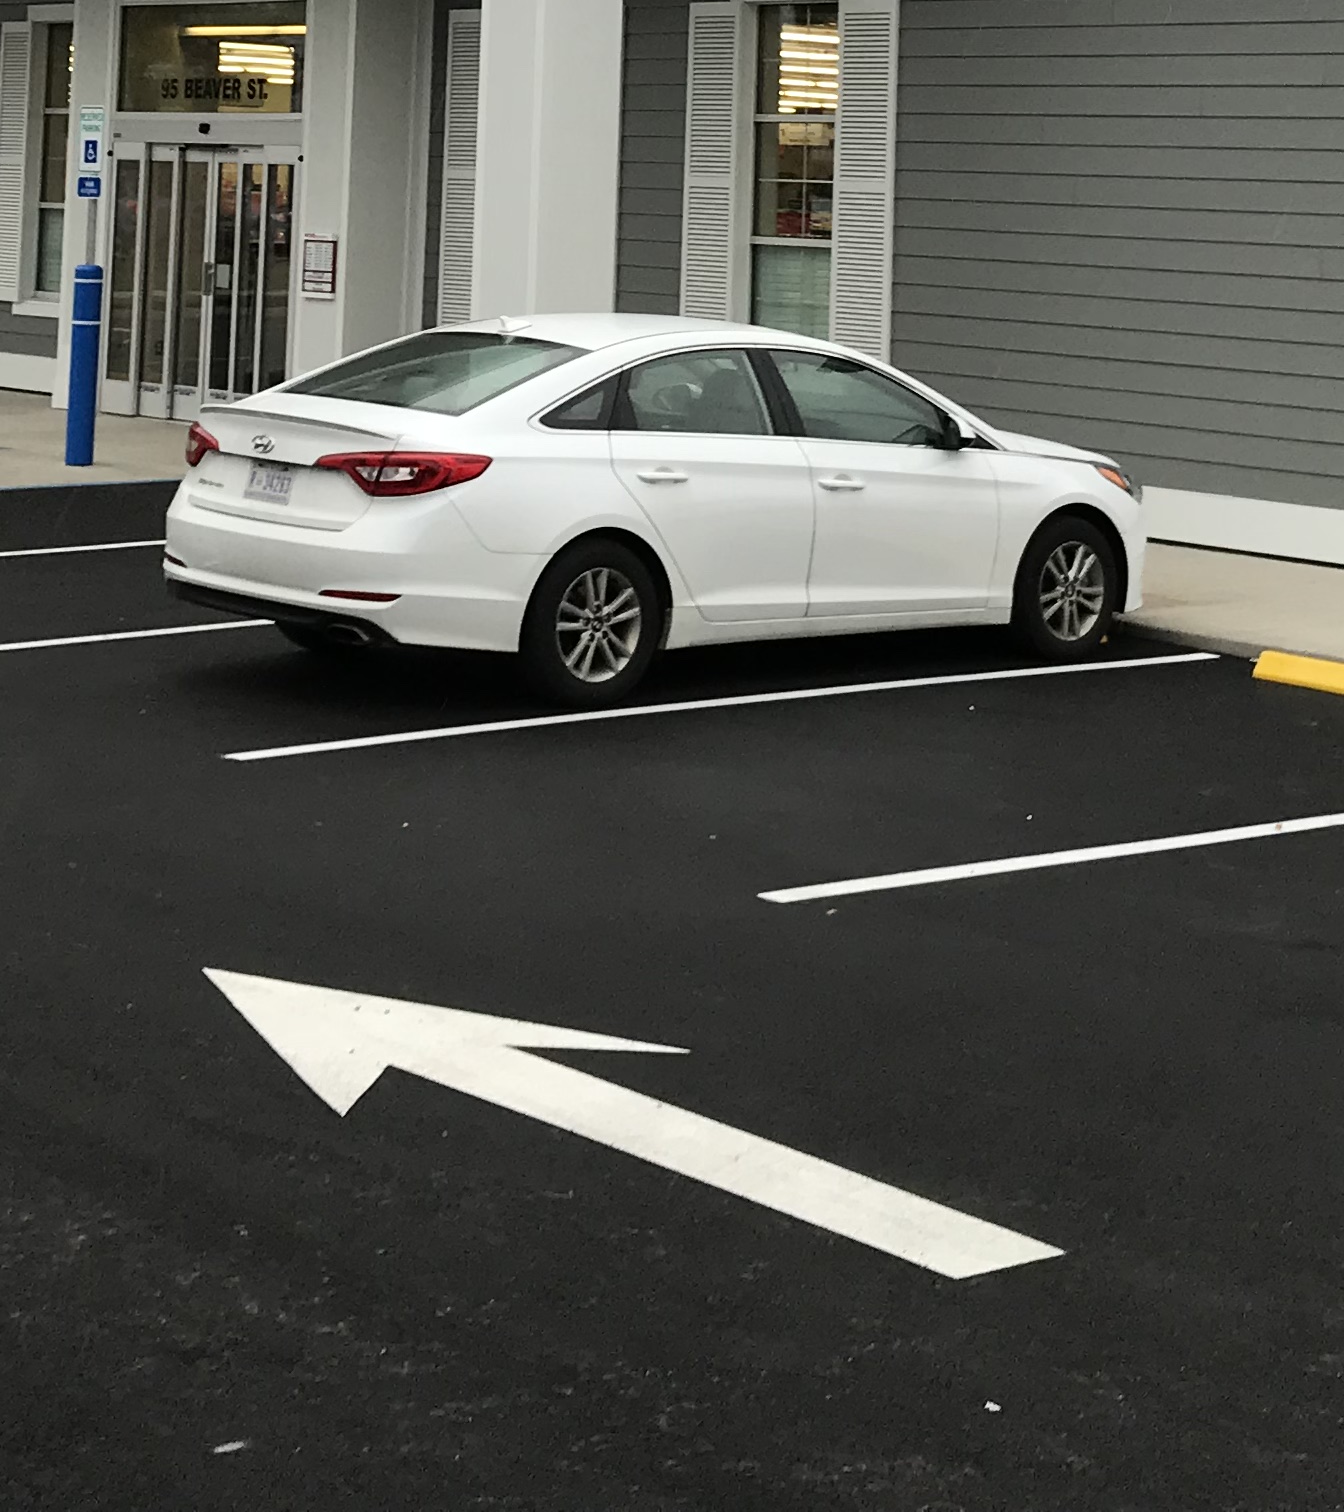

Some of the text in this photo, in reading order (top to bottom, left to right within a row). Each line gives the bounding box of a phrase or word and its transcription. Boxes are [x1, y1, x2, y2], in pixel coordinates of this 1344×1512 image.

[160, 77, 269, 100] 95 BEAVER ST.
